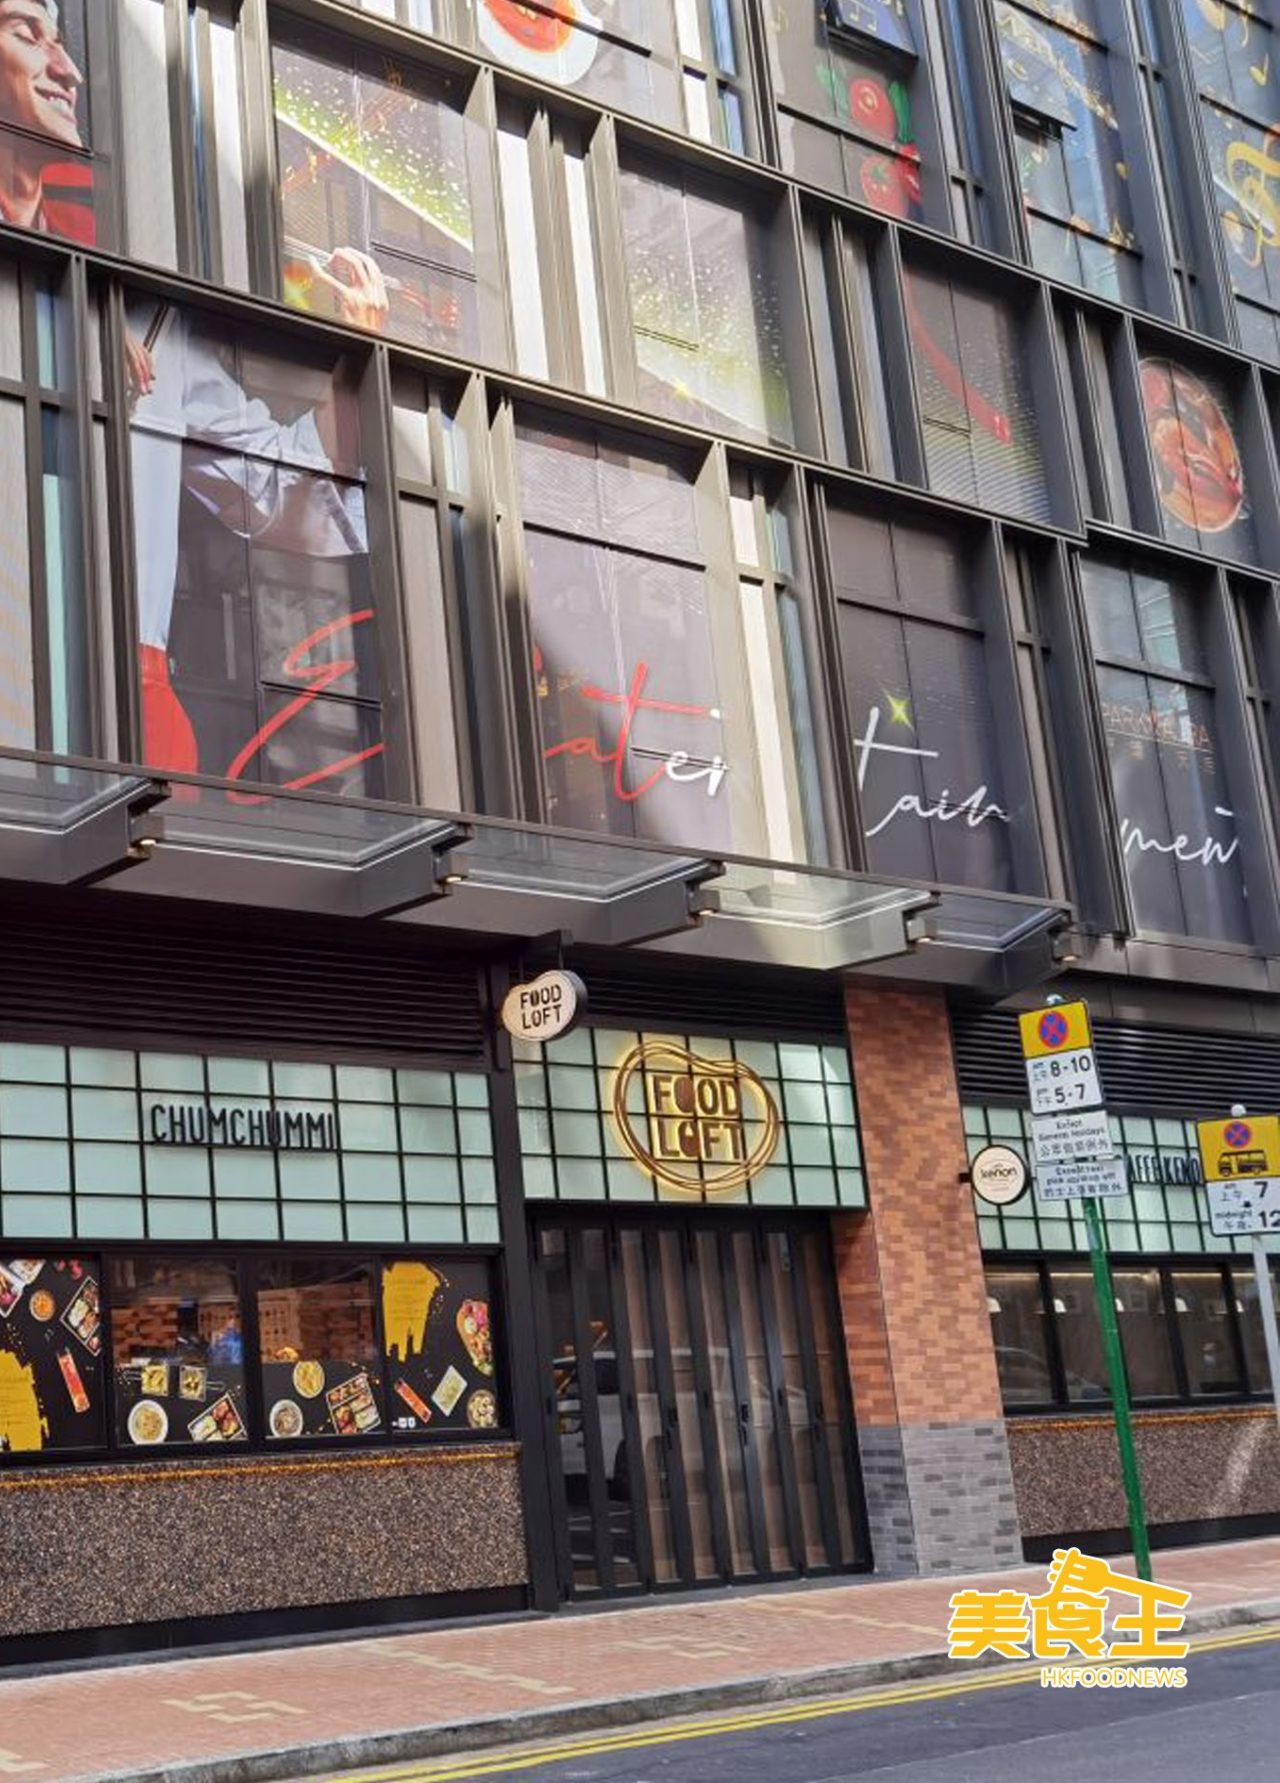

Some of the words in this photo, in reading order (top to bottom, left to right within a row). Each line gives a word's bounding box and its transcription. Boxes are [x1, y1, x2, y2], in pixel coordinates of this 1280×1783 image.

[520, 984, 562, 1010] FOOD
[522, 1004, 562, 1030] LOFT
[652, 1075, 742, 1116] FOOD
[150, 1103, 336, 1151] CHUMCHUMMI
[656, 1118, 742, 1160] LOFT
